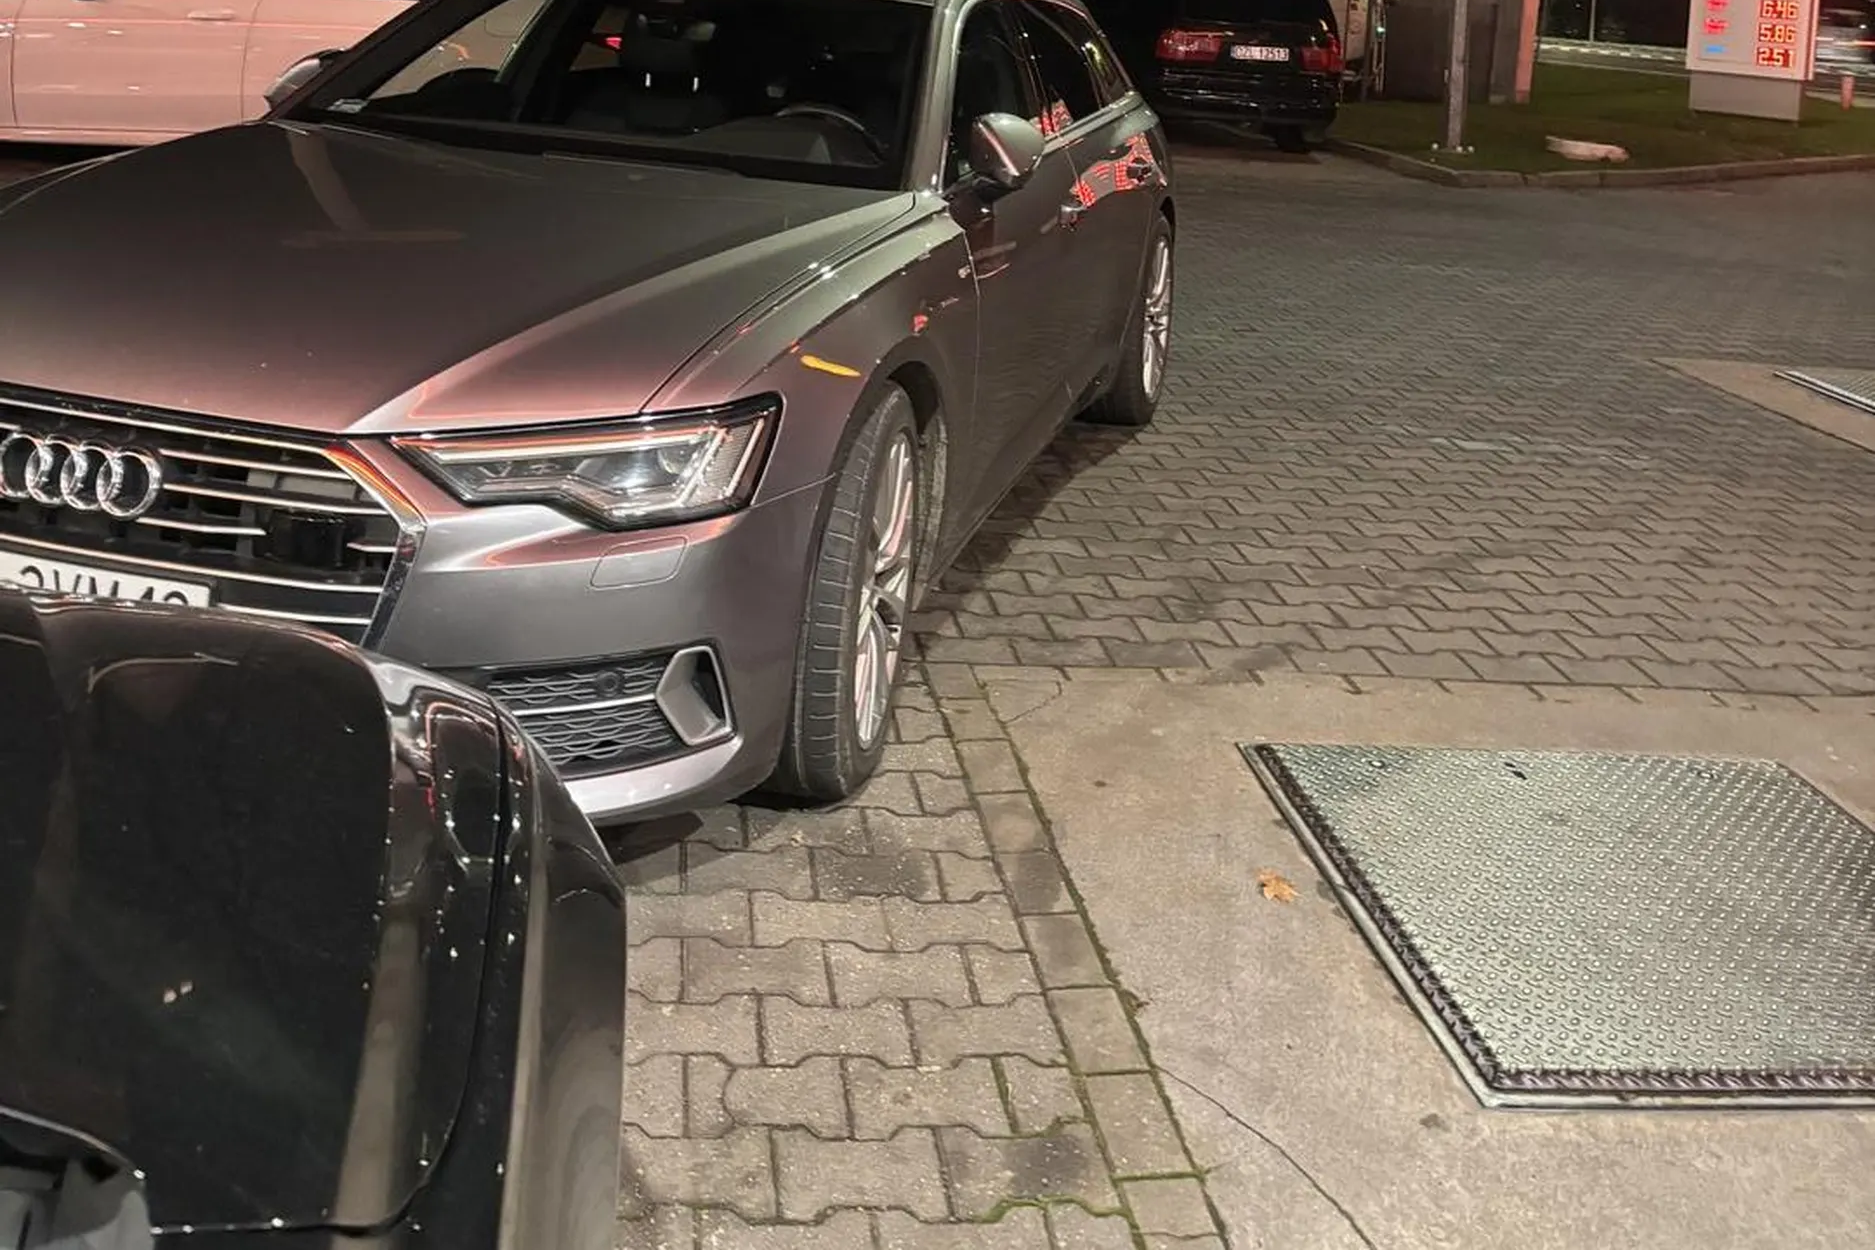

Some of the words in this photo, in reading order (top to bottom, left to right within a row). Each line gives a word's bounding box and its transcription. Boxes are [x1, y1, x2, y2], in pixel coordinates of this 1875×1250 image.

[1761, 0, 1800, 19] 6.46
[1759, 24, 1797, 43] 5.86
[1758, 48, 1795, 67] 2.51
